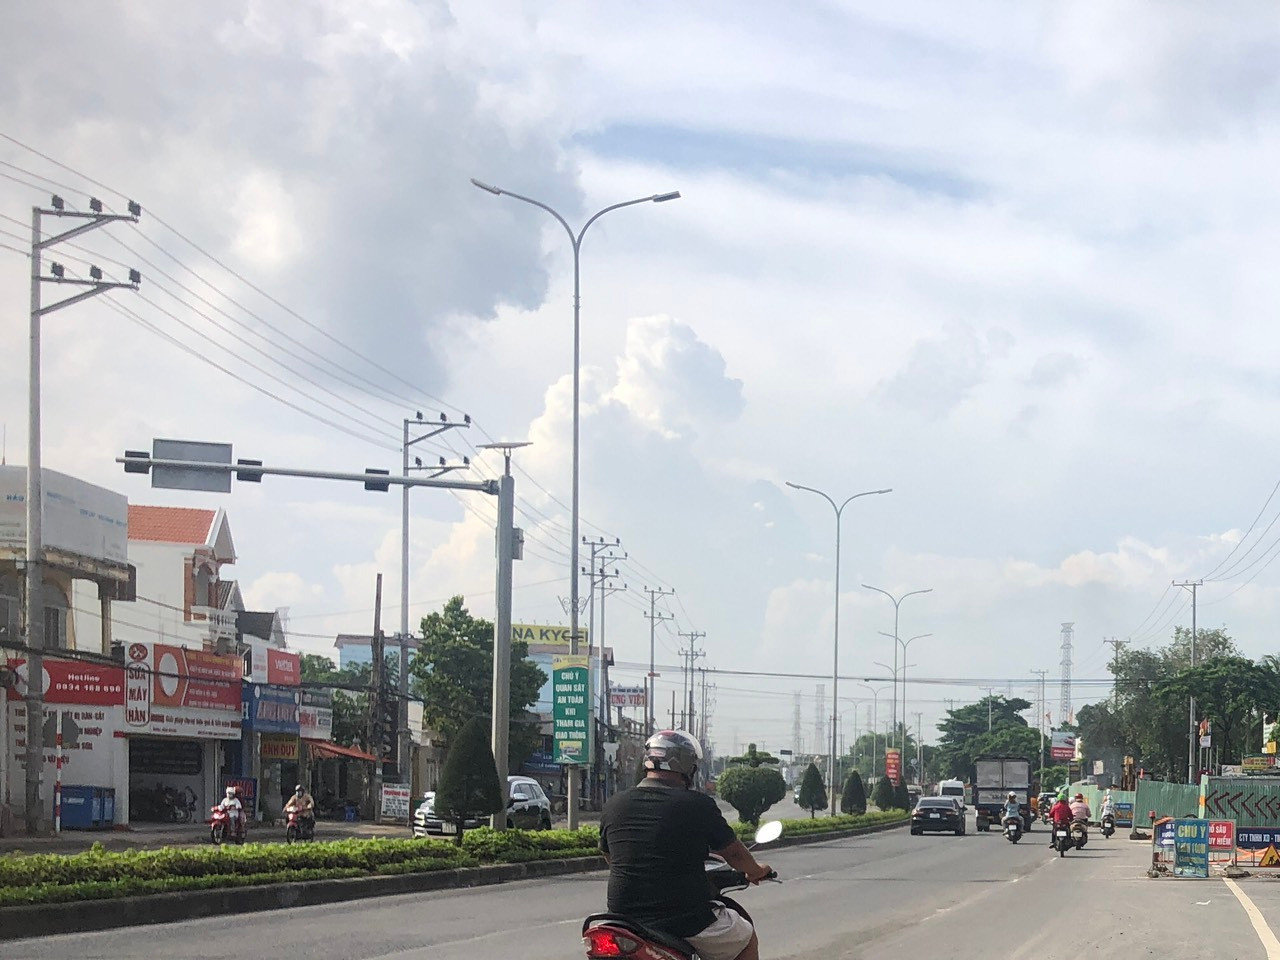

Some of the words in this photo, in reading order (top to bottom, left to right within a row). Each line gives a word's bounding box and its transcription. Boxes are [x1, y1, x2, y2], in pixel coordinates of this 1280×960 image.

[556, 684, 572, 692] QUAN
[128, 706, 146, 721] HÀN
[1239, 834, 1248, 842] CTY
[1249, 834, 1262, 842] TNHH
